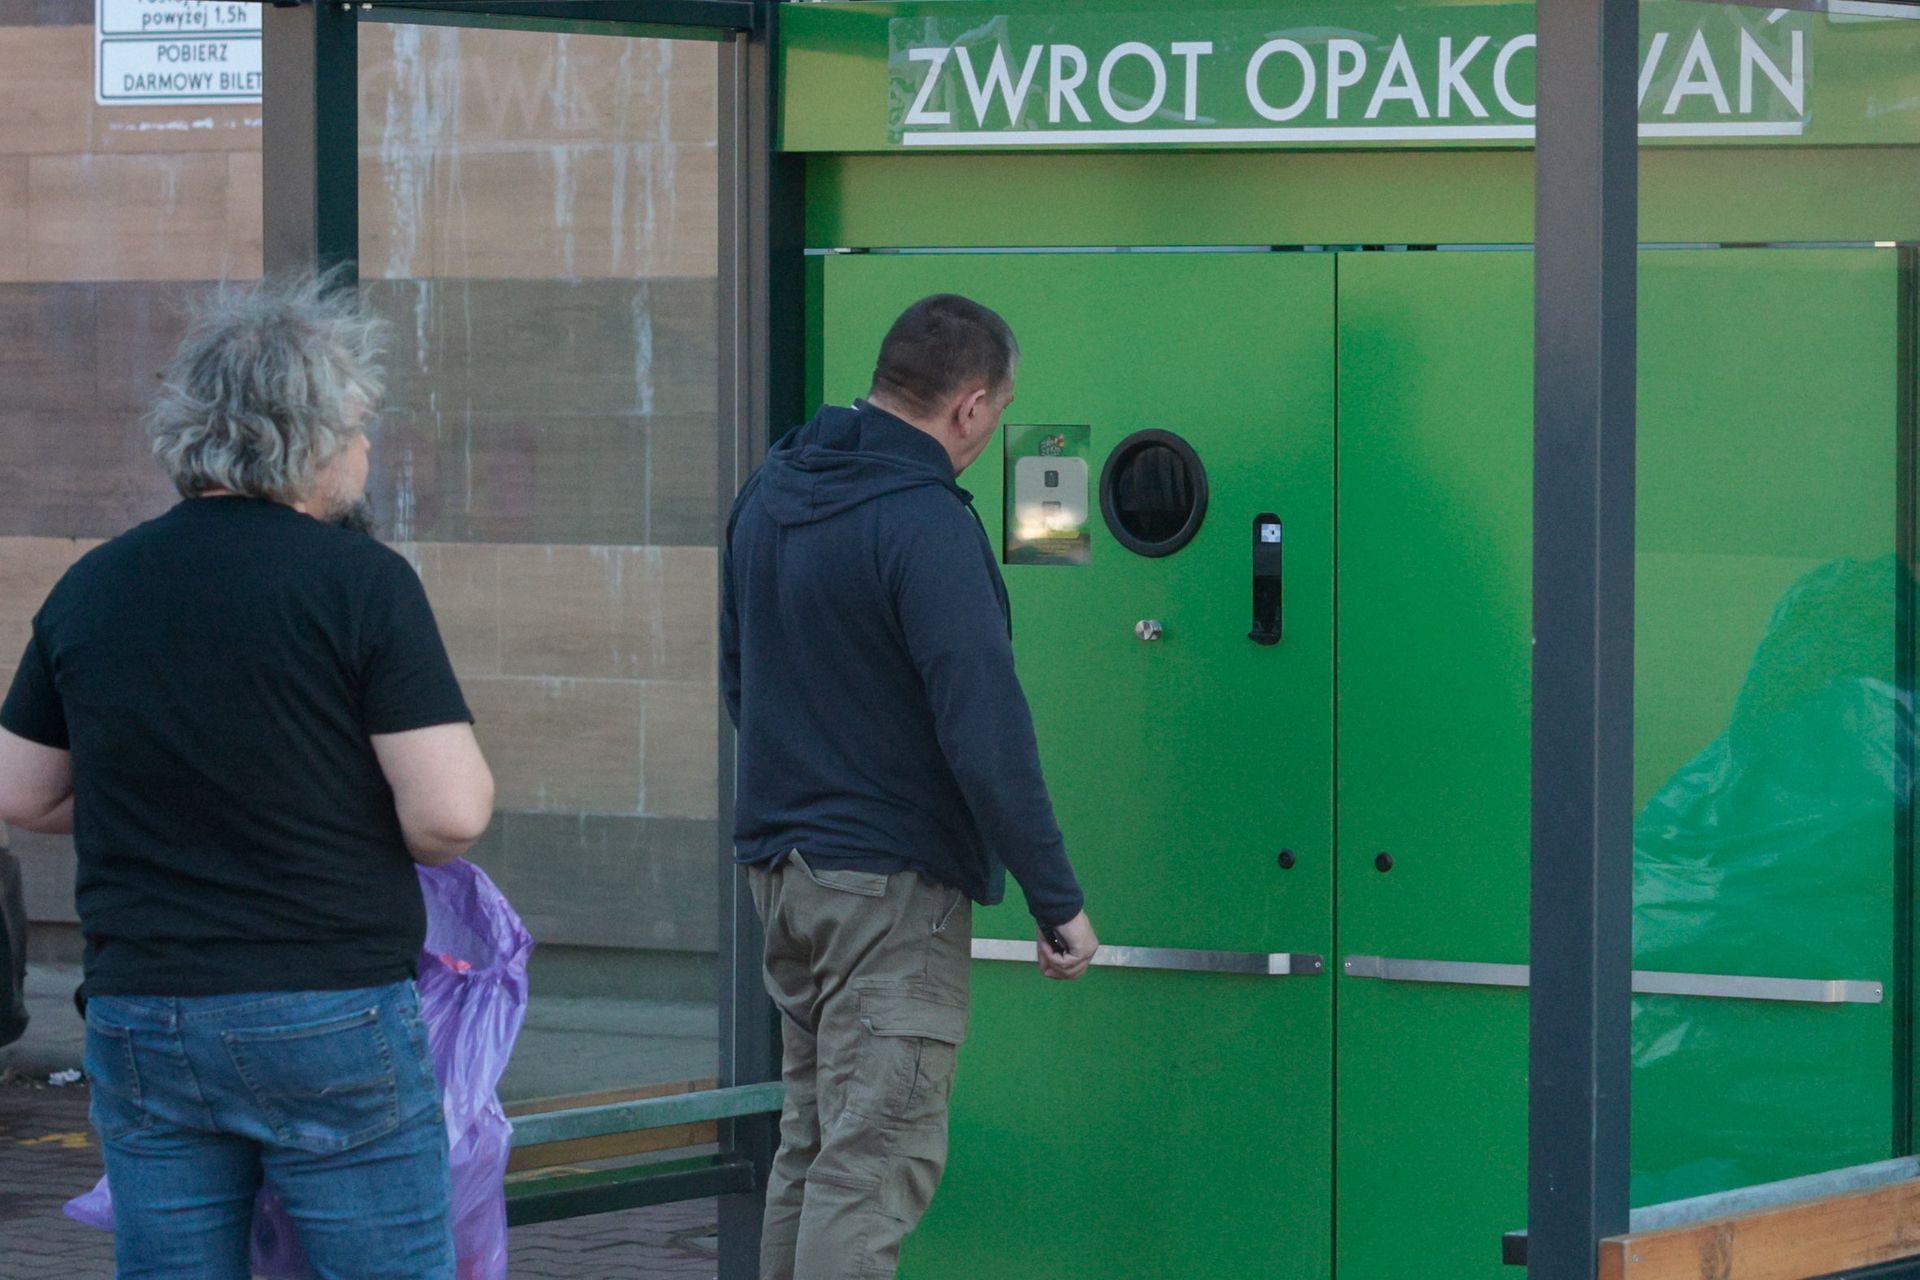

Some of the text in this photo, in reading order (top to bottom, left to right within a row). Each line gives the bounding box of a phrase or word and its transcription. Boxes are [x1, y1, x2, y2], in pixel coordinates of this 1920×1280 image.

[142, 9, 208, 31] powyżej
[157, 43, 228, 62] POBIERZ
[124, 72, 213, 91] DARMOWY
[904, 41, 1214, 128] ZWROT
